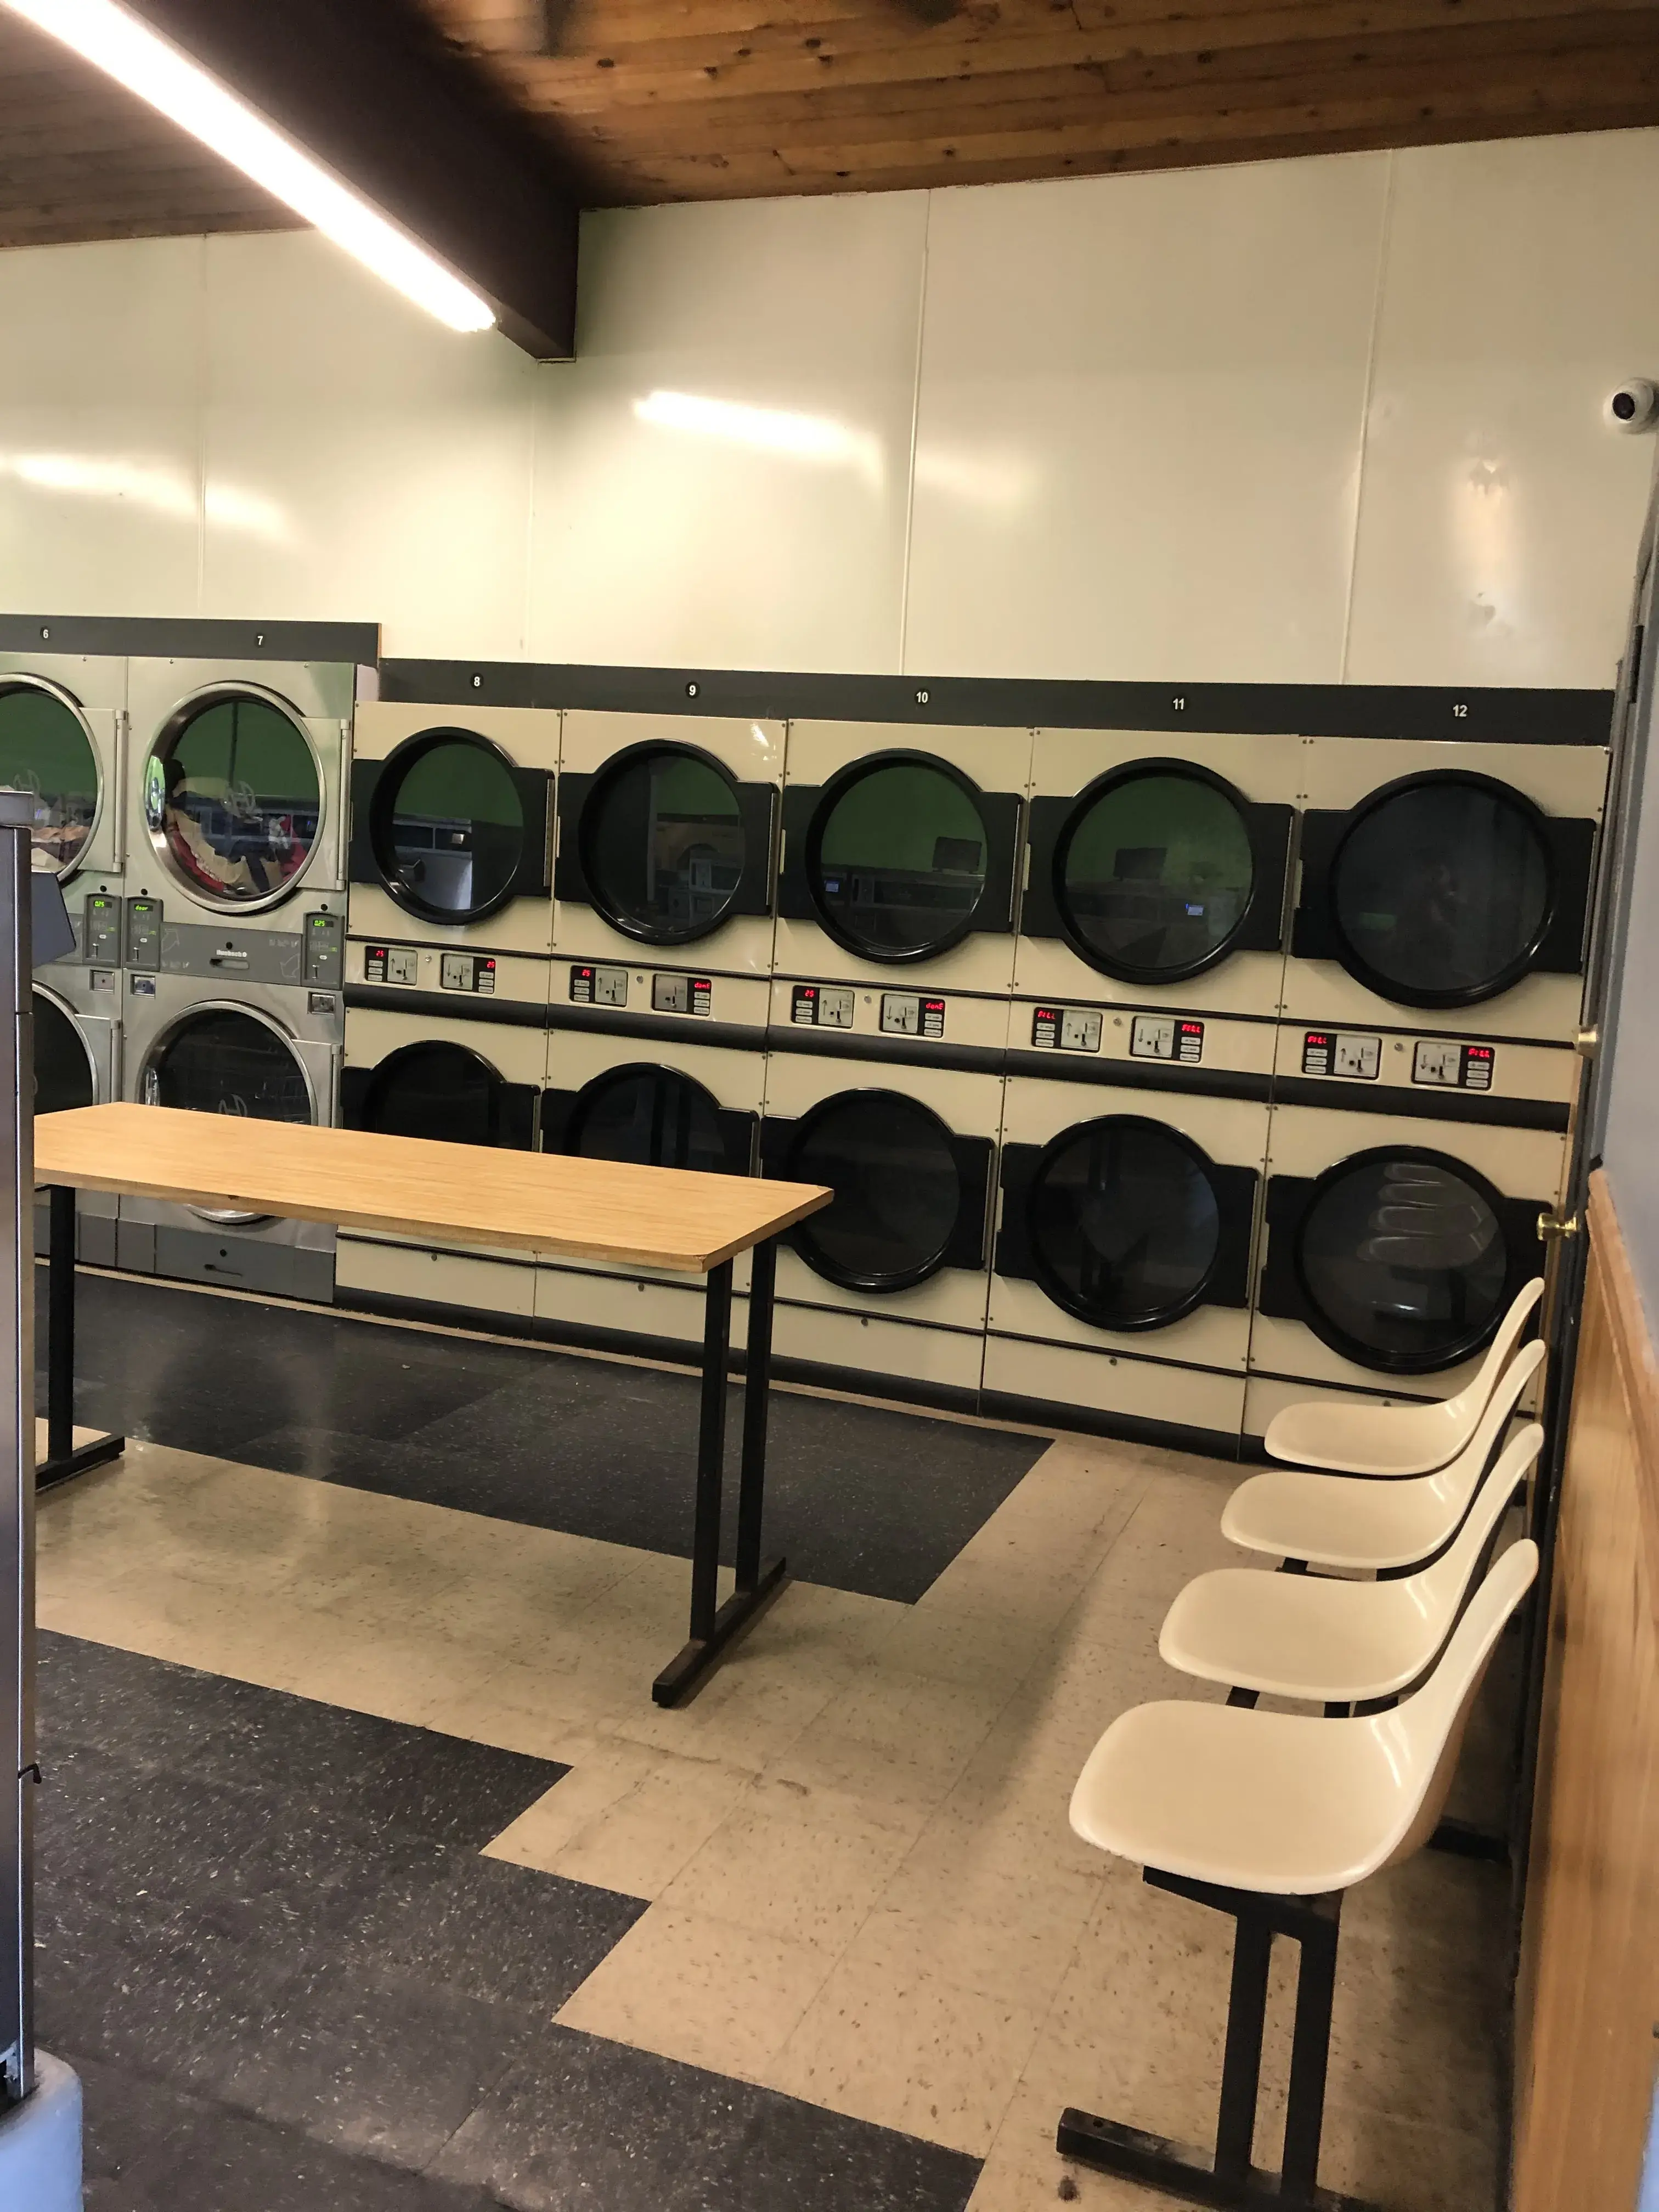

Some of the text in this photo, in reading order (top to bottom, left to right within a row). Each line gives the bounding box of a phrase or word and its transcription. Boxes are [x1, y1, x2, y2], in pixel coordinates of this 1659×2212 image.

[43, 629, 49, 639] 6
[257, 635, 263, 645] 7
[473, 676, 480, 687] 8
[689, 685, 696, 696] 9
[916, 691, 928, 703] 10
[1173, 698, 1184, 710] 11
[1453, 704, 1468, 717] 12
